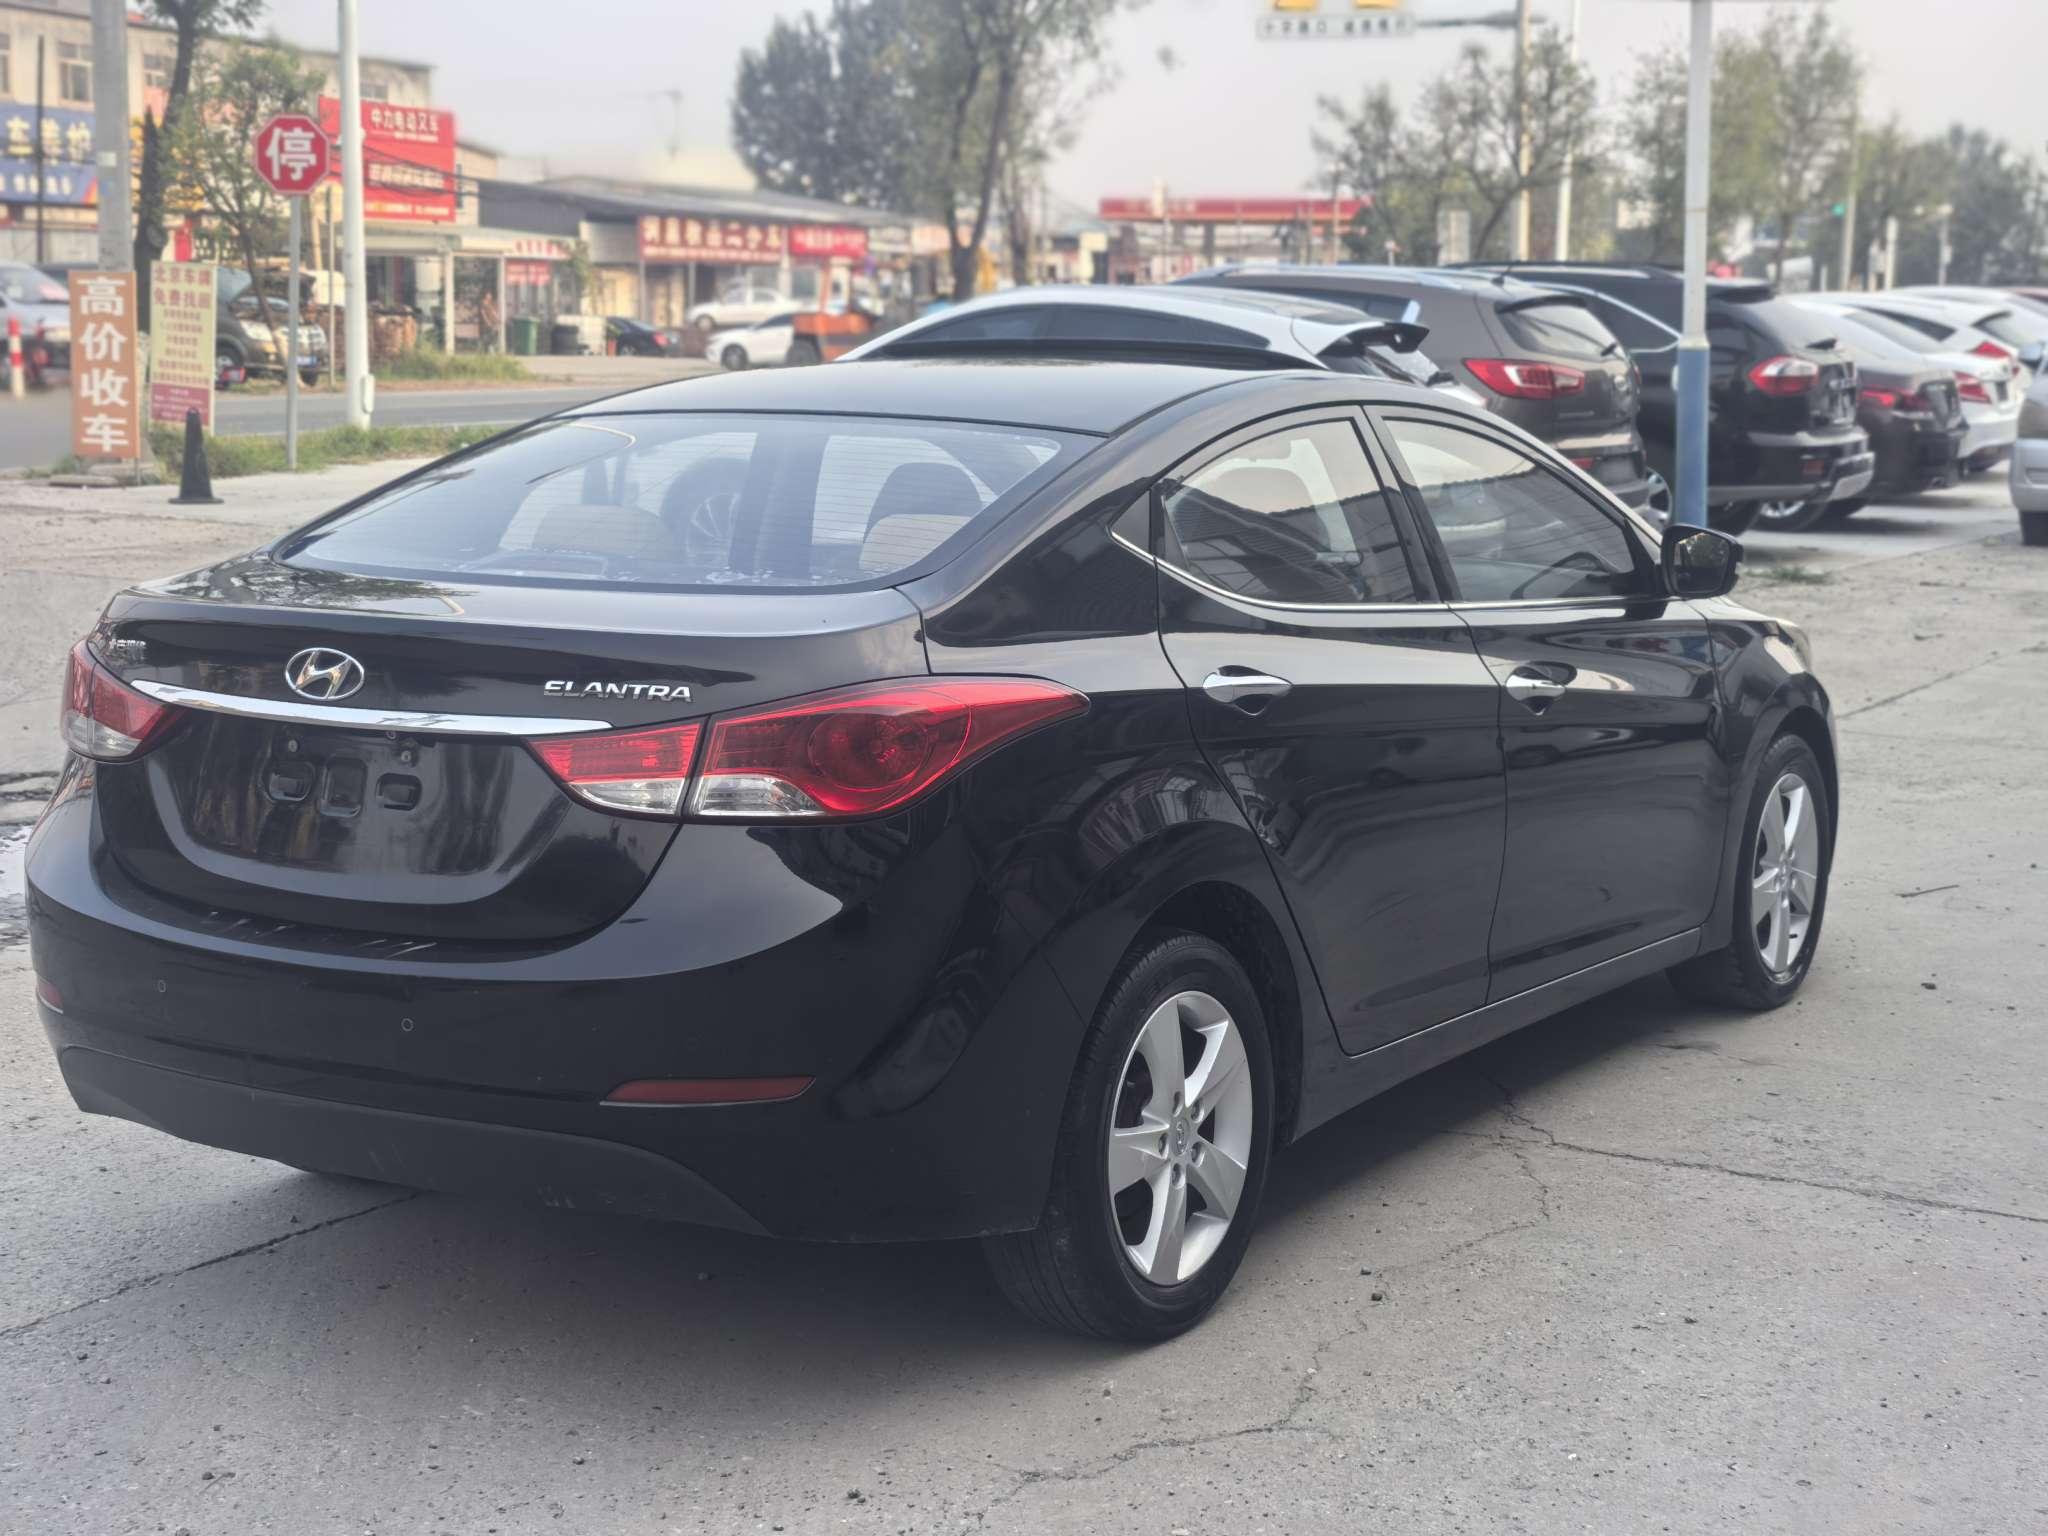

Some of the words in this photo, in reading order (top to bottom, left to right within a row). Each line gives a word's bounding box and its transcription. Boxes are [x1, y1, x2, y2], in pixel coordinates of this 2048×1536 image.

[265, 127, 317, 181] 停
[77, 276, 129, 452] 高价收车
[543, 680, 694, 702] ELANTRA
